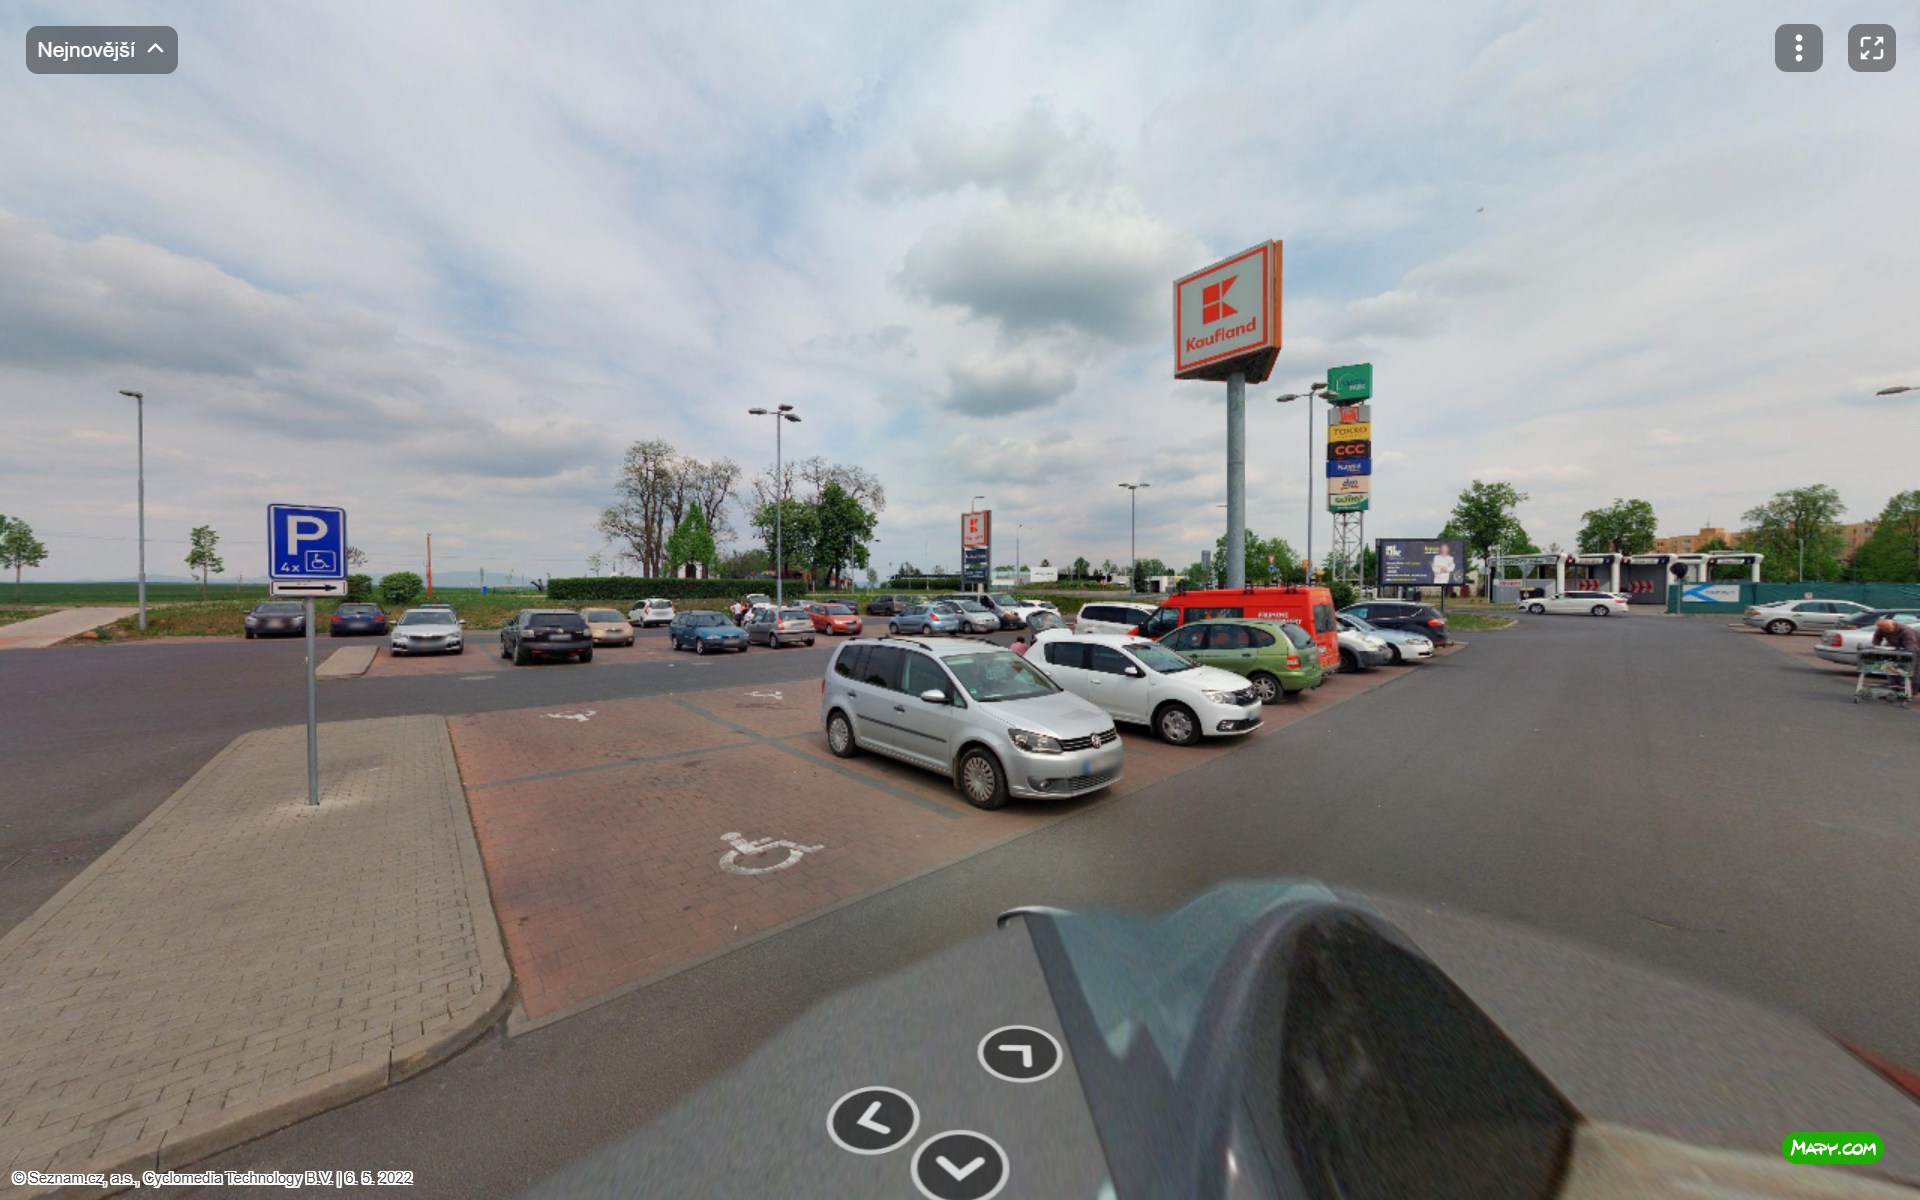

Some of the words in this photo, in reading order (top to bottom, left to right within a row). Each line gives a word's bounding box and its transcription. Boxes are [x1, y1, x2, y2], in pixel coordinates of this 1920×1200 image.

[1186, 315, 1257, 353] Kaufland
[1335, 443, 1365, 456] CCC
[287, 514, 328, 556] P
